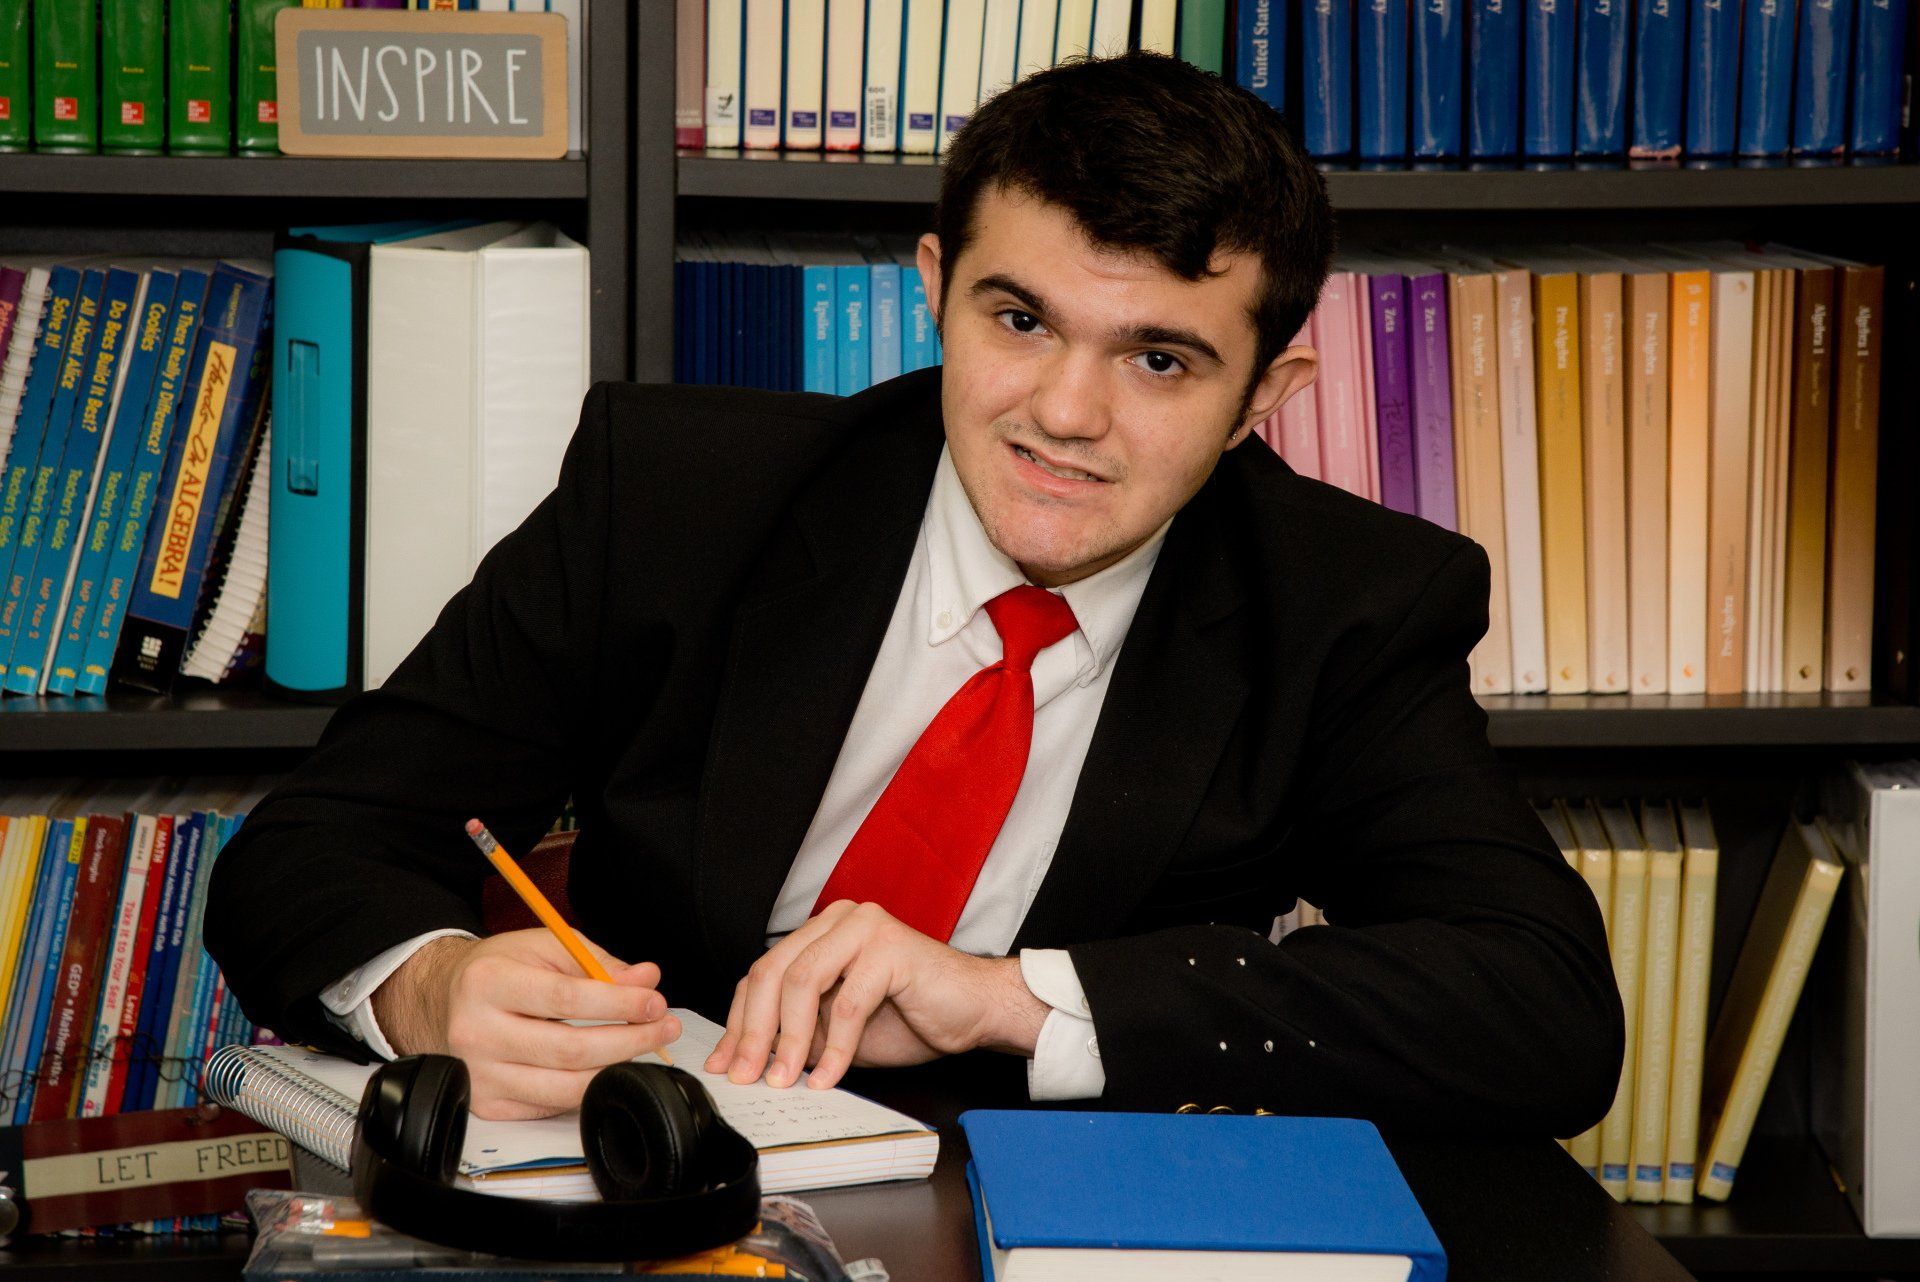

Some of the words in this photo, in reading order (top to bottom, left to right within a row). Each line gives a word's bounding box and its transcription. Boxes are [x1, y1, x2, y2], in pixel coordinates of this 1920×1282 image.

[1252, 39, 1268, 88] United
[315, 45, 528, 124] INSPIRE
[48, 295, 70, 331] Solve
[78, 295, 97, 316] All
[108, 299, 127, 320] Do
[68, 315, 92, 356] About
[100, 319, 122, 351] Bees
[139, 301, 167, 353] Cookies
[172, 313, 194, 346] There
[60, 356, 83, 390] Alice
[92, 351, 114, 385] Build
[161, 344, 185, 381] Really
[161, 381, 173, 389] a
[80, 397, 103, 432] Best?
[144, 390, 175, 455] Difference?
[186, 350, 231, 466] Hands-On
[157, 469, 204, 587] ALGEBRA!
[150, 830, 169, 864] MATH
[120, 899, 136, 926] Take
[105, 984, 120, 1009] Seat
[97, 1151, 157, 1184] LET
[196, 1137, 288, 1173] FREED
